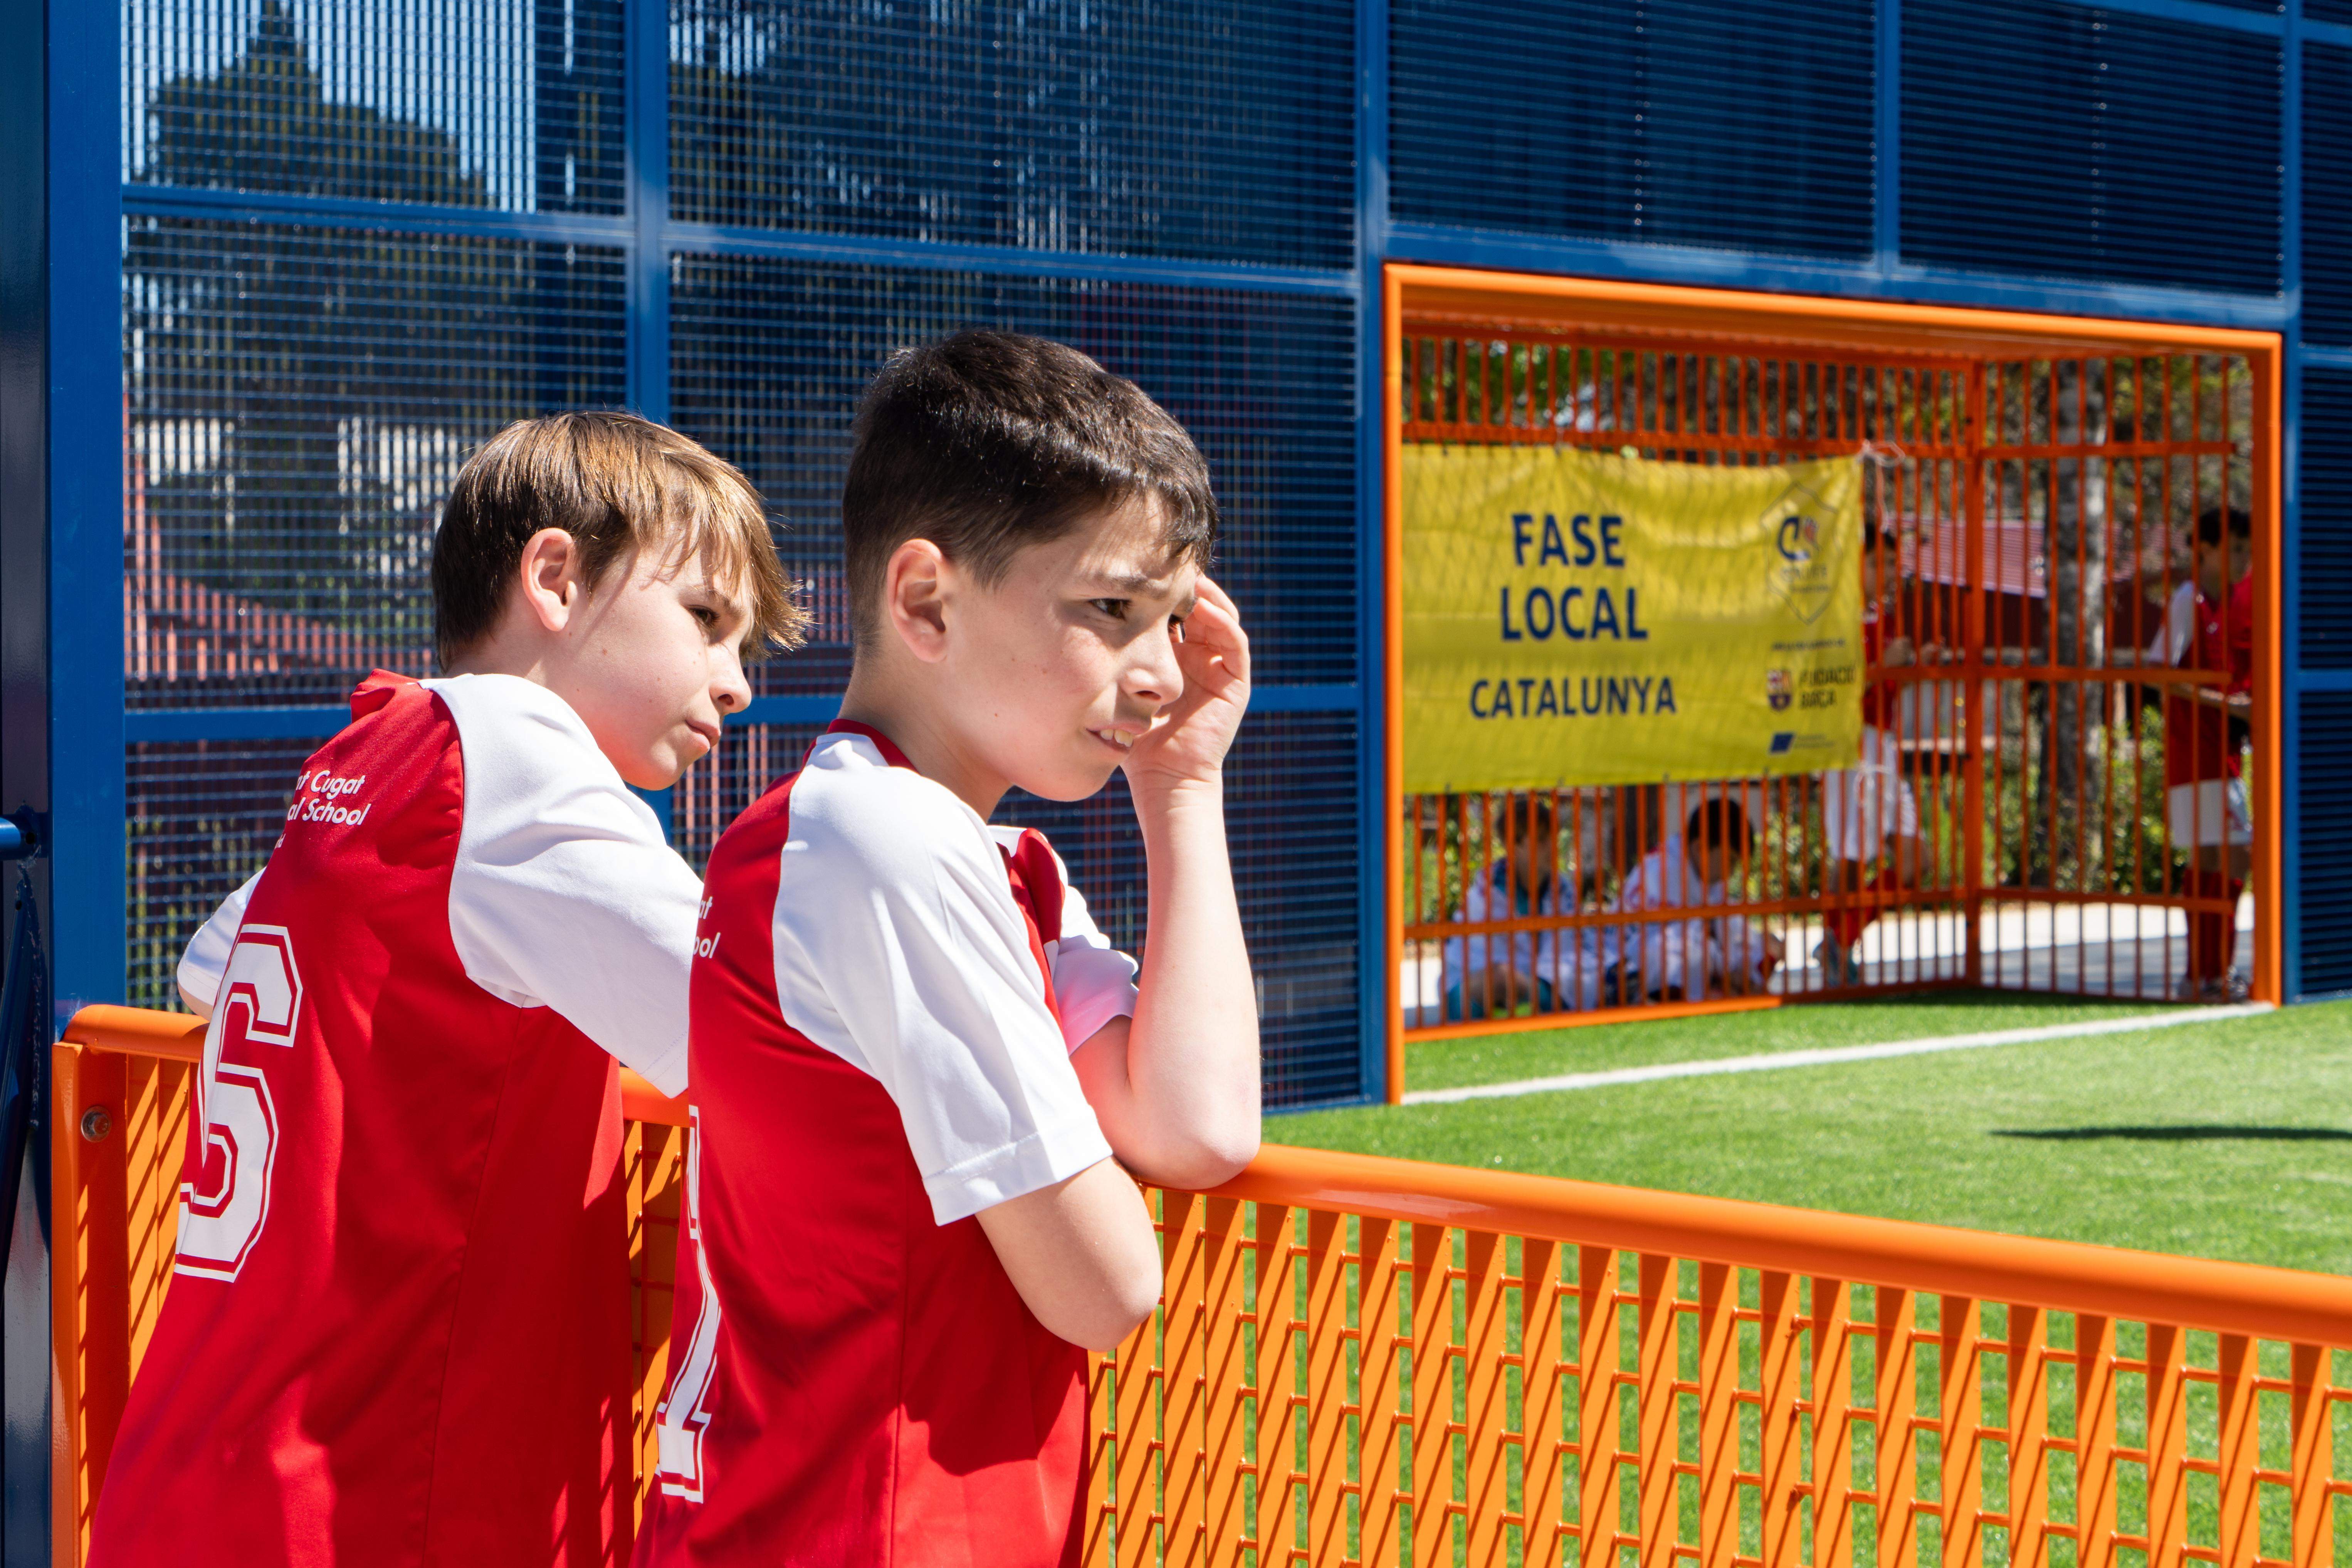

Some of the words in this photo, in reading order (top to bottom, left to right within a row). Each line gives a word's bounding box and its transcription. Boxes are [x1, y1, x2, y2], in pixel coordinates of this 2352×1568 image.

[1511, 513, 1625, 568] FASE
[1500, 587, 1649, 641] LOCAL
[1470, 677, 1677, 719] CATALUNYA
[311, 770, 366, 800] Cugat
[302, 798, 371, 825] School
